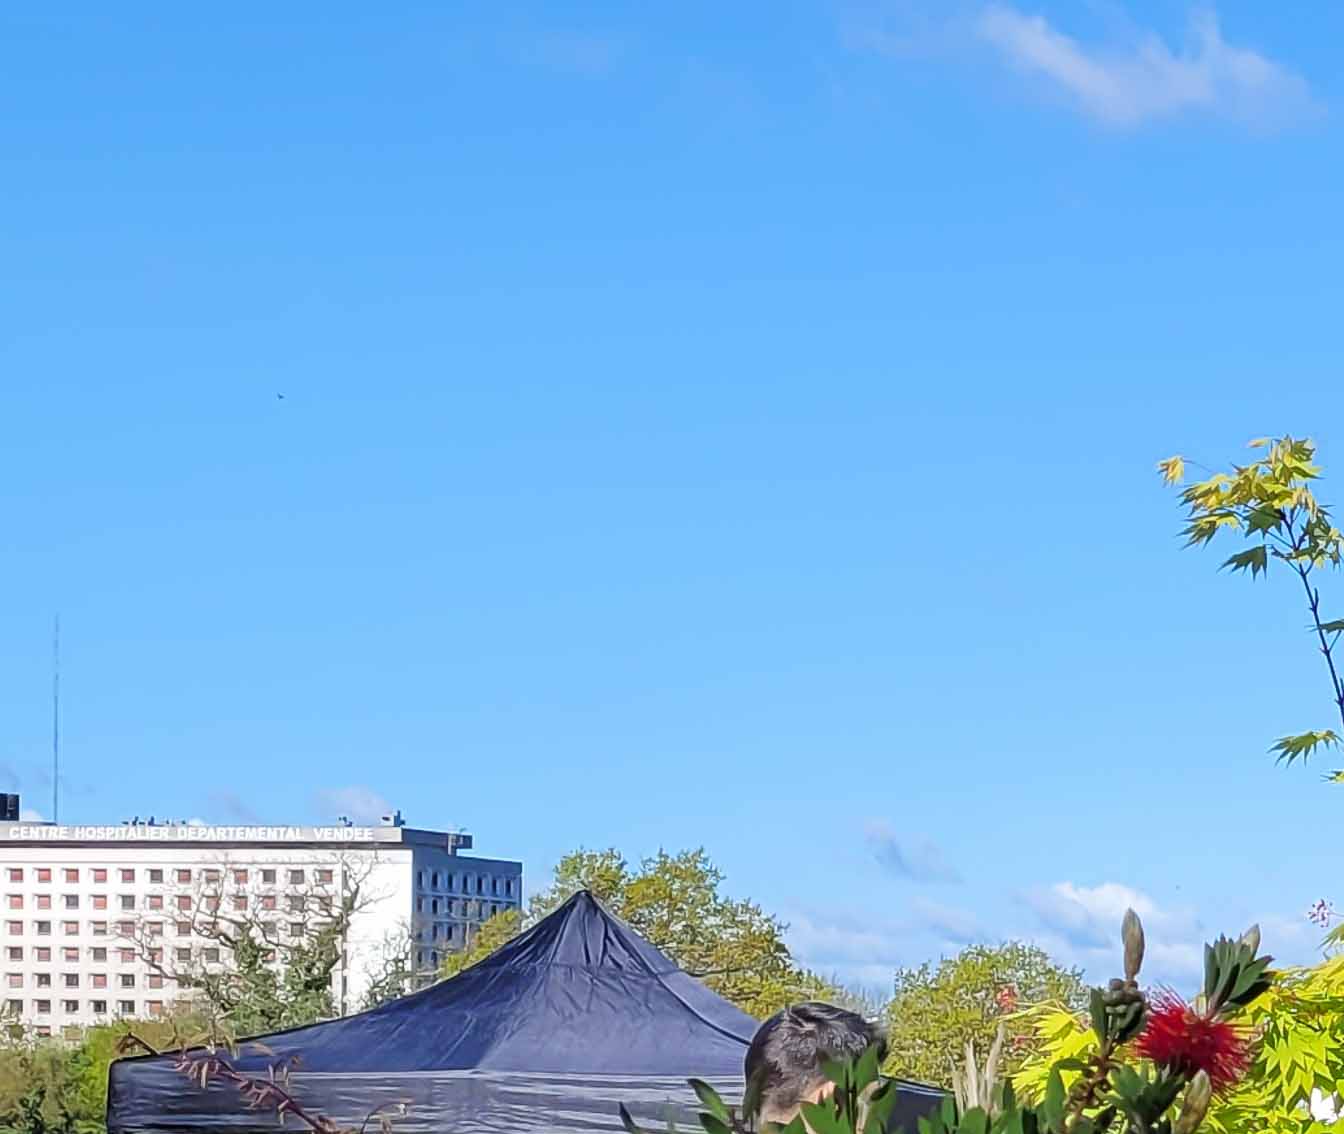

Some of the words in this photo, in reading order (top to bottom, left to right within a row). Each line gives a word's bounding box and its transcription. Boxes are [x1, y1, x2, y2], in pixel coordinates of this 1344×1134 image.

[9, 827, 68, 839] CENTRE
[75, 827, 169, 839] HOSPITALIER
[177, 827, 304, 840] DEPARTEMENTAL
[313, 828, 374, 841] VENDEE
